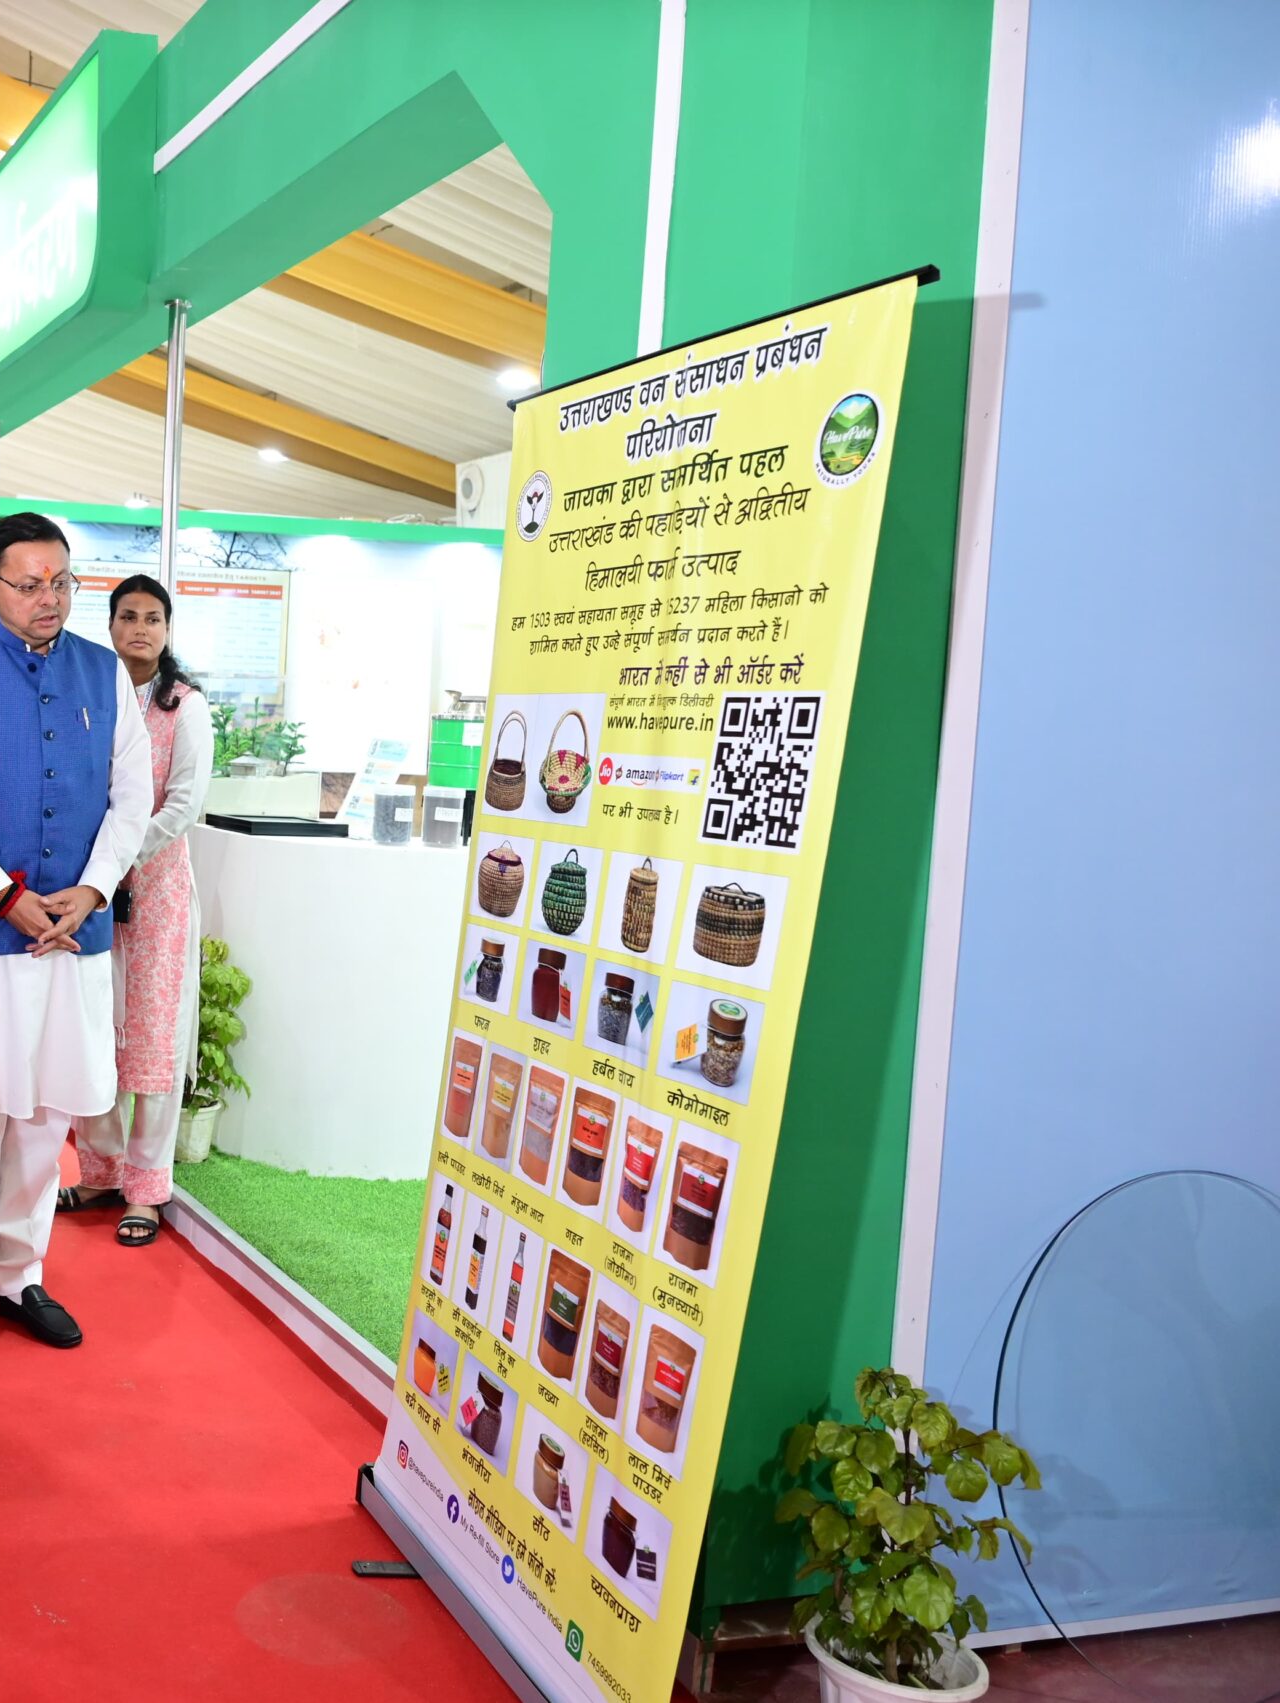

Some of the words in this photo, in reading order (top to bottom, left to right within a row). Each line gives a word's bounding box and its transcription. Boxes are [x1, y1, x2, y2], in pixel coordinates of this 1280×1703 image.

[560, 385, 635, 431] उत्तराखण्ड
[639, 374, 670, 406] वन
[675, 353, 750, 398] संसाधन
[756, 323, 828, 378] प्रबंधन
[626, 413, 717, 460] परियोजना
[563, 481, 617, 512] जायका
[621, 473, 655, 505] द्वारा
[660, 449, 733, 493] समर्थित
[739, 444, 789, 478] पहल
[549, 515, 616, 553] उत्तराखंड
[619, 509, 643, 541] की
[645, 495, 710, 537] पहाड़ियों
[713, 493, 733, 526] से
[735, 482, 812, 526] अद्वितीय
[585, 554, 644, 591] हिमालयी
[647, 546, 681, 582] फार्म
[682, 550, 742, 577] उत्पाद
[511, 616, 527, 632] हम
[530, 611, 551, 629] 1503
[553, 605, 575, 627] स्वयं
[578, 606, 618, 625] सहायता
[620, 603, 646, 625] समूह
[650, 598, 662, 618] से
[704, 591, 746, 614] महिला
[809, 582, 829, 605] को
[529, 635, 559, 655] शामिल
[562, 633, 583, 652] करते
[585, 636, 600, 656] हुए
[623, 626, 655, 653] संपूर्ण
[657, 622, 693, 646] समर्थन
[697, 626, 732, 644] प्रदान
[736, 619, 768, 642] करते
[619, 666, 652, 687] भारत
[694, 658, 710, 685] से
[714, 656, 733, 684] भी
[736, 654, 776, 684] ऑर्डर
[779, 652, 805, 685] करें
[626, 697, 647, 707] भारत
[680, 692, 715, 708] डिलीवरी
[607, 712, 714, 735] www.havepure.in
[599, 763, 612, 777] Jio
[626, 768, 656, 780] amazon
[602, 804, 616, 817] पर
[618, 801, 634, 818] भी
[533, 1036, 551, 1056] शहद
[592, 1058, 616, 1080] हर्बल
[666, 1088, 730, 1127] कोमोमाइल
[565, 1228, 584, 1247] गहत
[612, 1241, 634, 1263] राजमा
[668, 1272, 698, 1298] राजमा
[652, 1286, 704, 1327] (मुनस्यारी)
[579, 1427, 610, 1464] (हरसिल)
[585, 1415, 608, 1442] राजमा
[628, 1452, 650, 1475] लाल
[652, 1464, 673, 1491] मिर्च
[632, 1473, 663, 1504] पाउडर
[460, 1514, 469, 1532] My
[485, 1541, 500, 1565] Store
[547, 1608, 563, 1633] India
[590, 1574, 642, 1633] च्यवनप्राश
